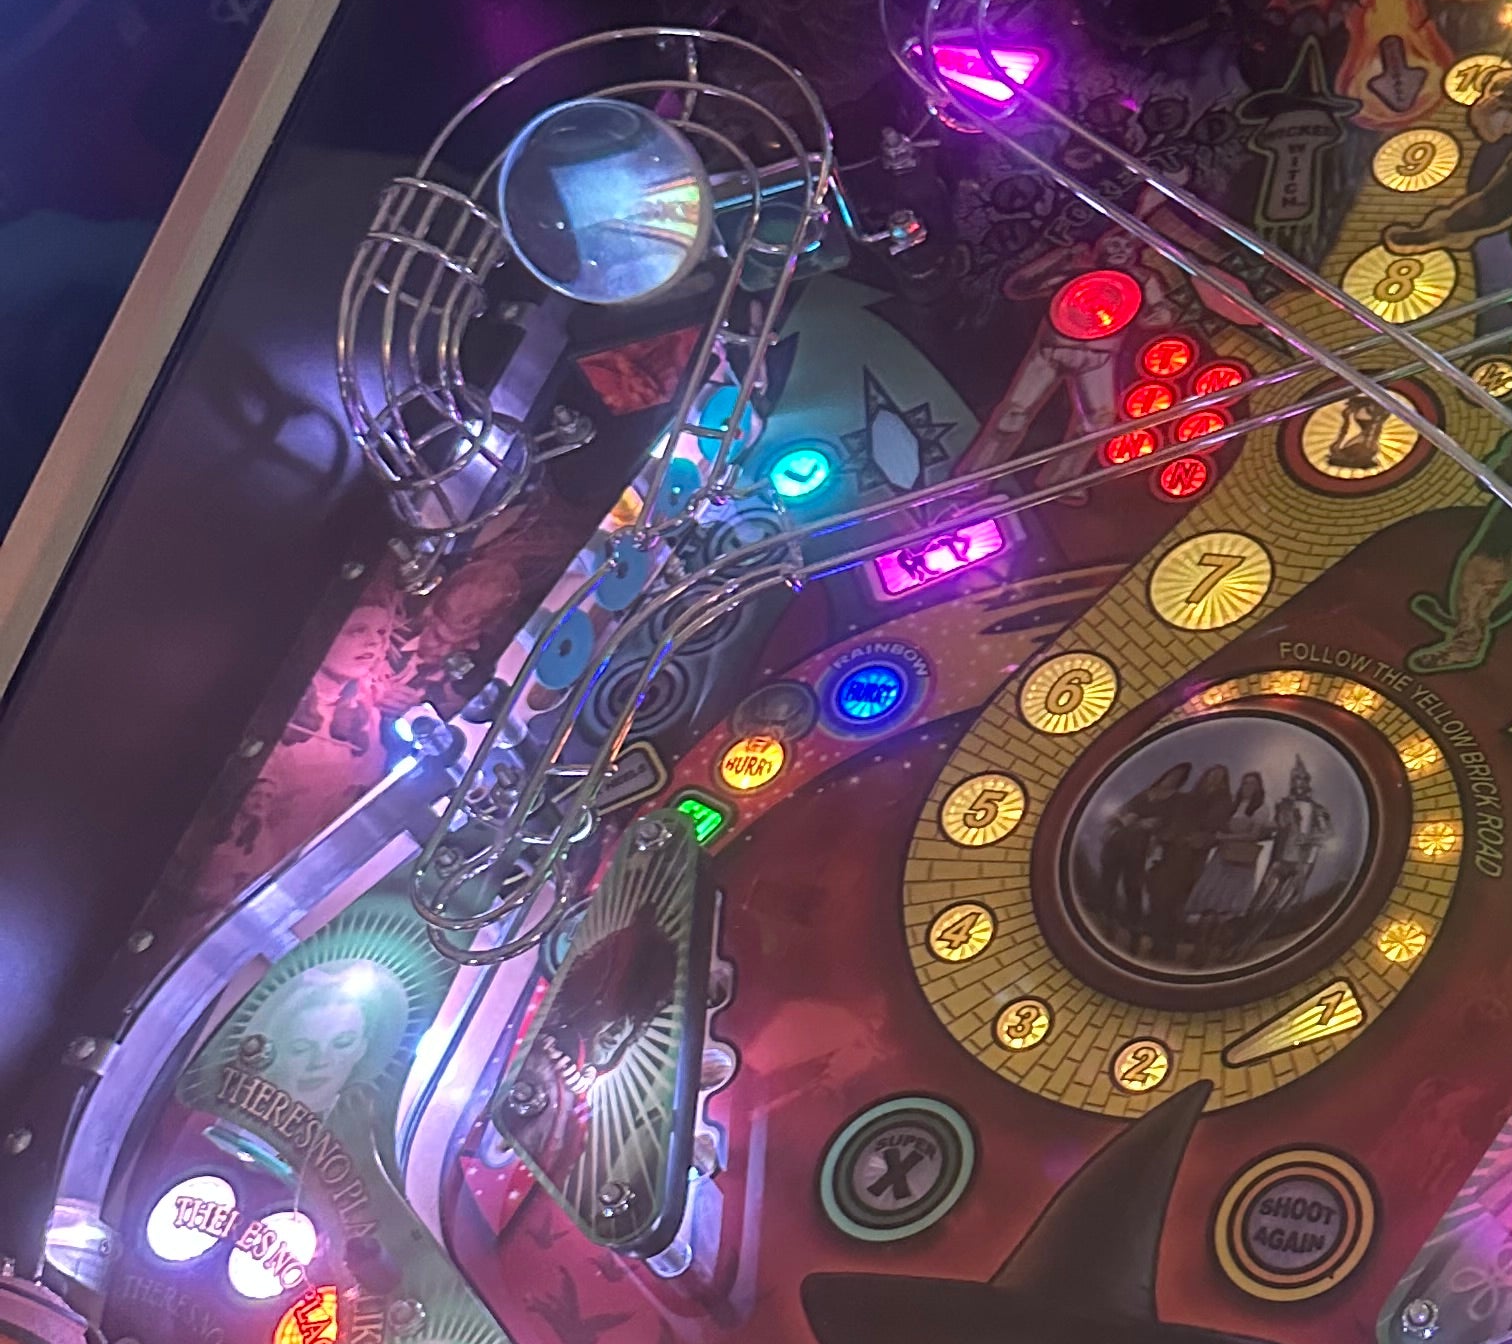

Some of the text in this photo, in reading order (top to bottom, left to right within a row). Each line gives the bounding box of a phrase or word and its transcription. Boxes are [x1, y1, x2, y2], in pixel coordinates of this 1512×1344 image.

[1395, 142, 1436, 176] 9
[1373, 258, 1424, 303] 8
[1185, 552, 1247, 604] 7
[833, 642, 929, 676] RAINBOW
[1044, 668, 1093, 716] 6
[1279, 642, 1505, 879] FOLLOW THE YELLOW BRICK ROAD
[963, 789, 1007, 830] 5
[939, 912, 981, 950] 4
[1006, 1003, 1040, 1040] 3
[1316, 989, 1346, 1027] 1
[1121, 1046, 1158, 1084] 2
[217, 1066, 321, 1149] THERE'S
[309, 1129, 350, 1183] NO
[874, 1133, 937, 1158] SUPER
[867, 1146, 927, 1201] X
[1258, 1196, 1337, 1226] SHOOT
[1252, 1225, 1326, 1255] AGAIN
